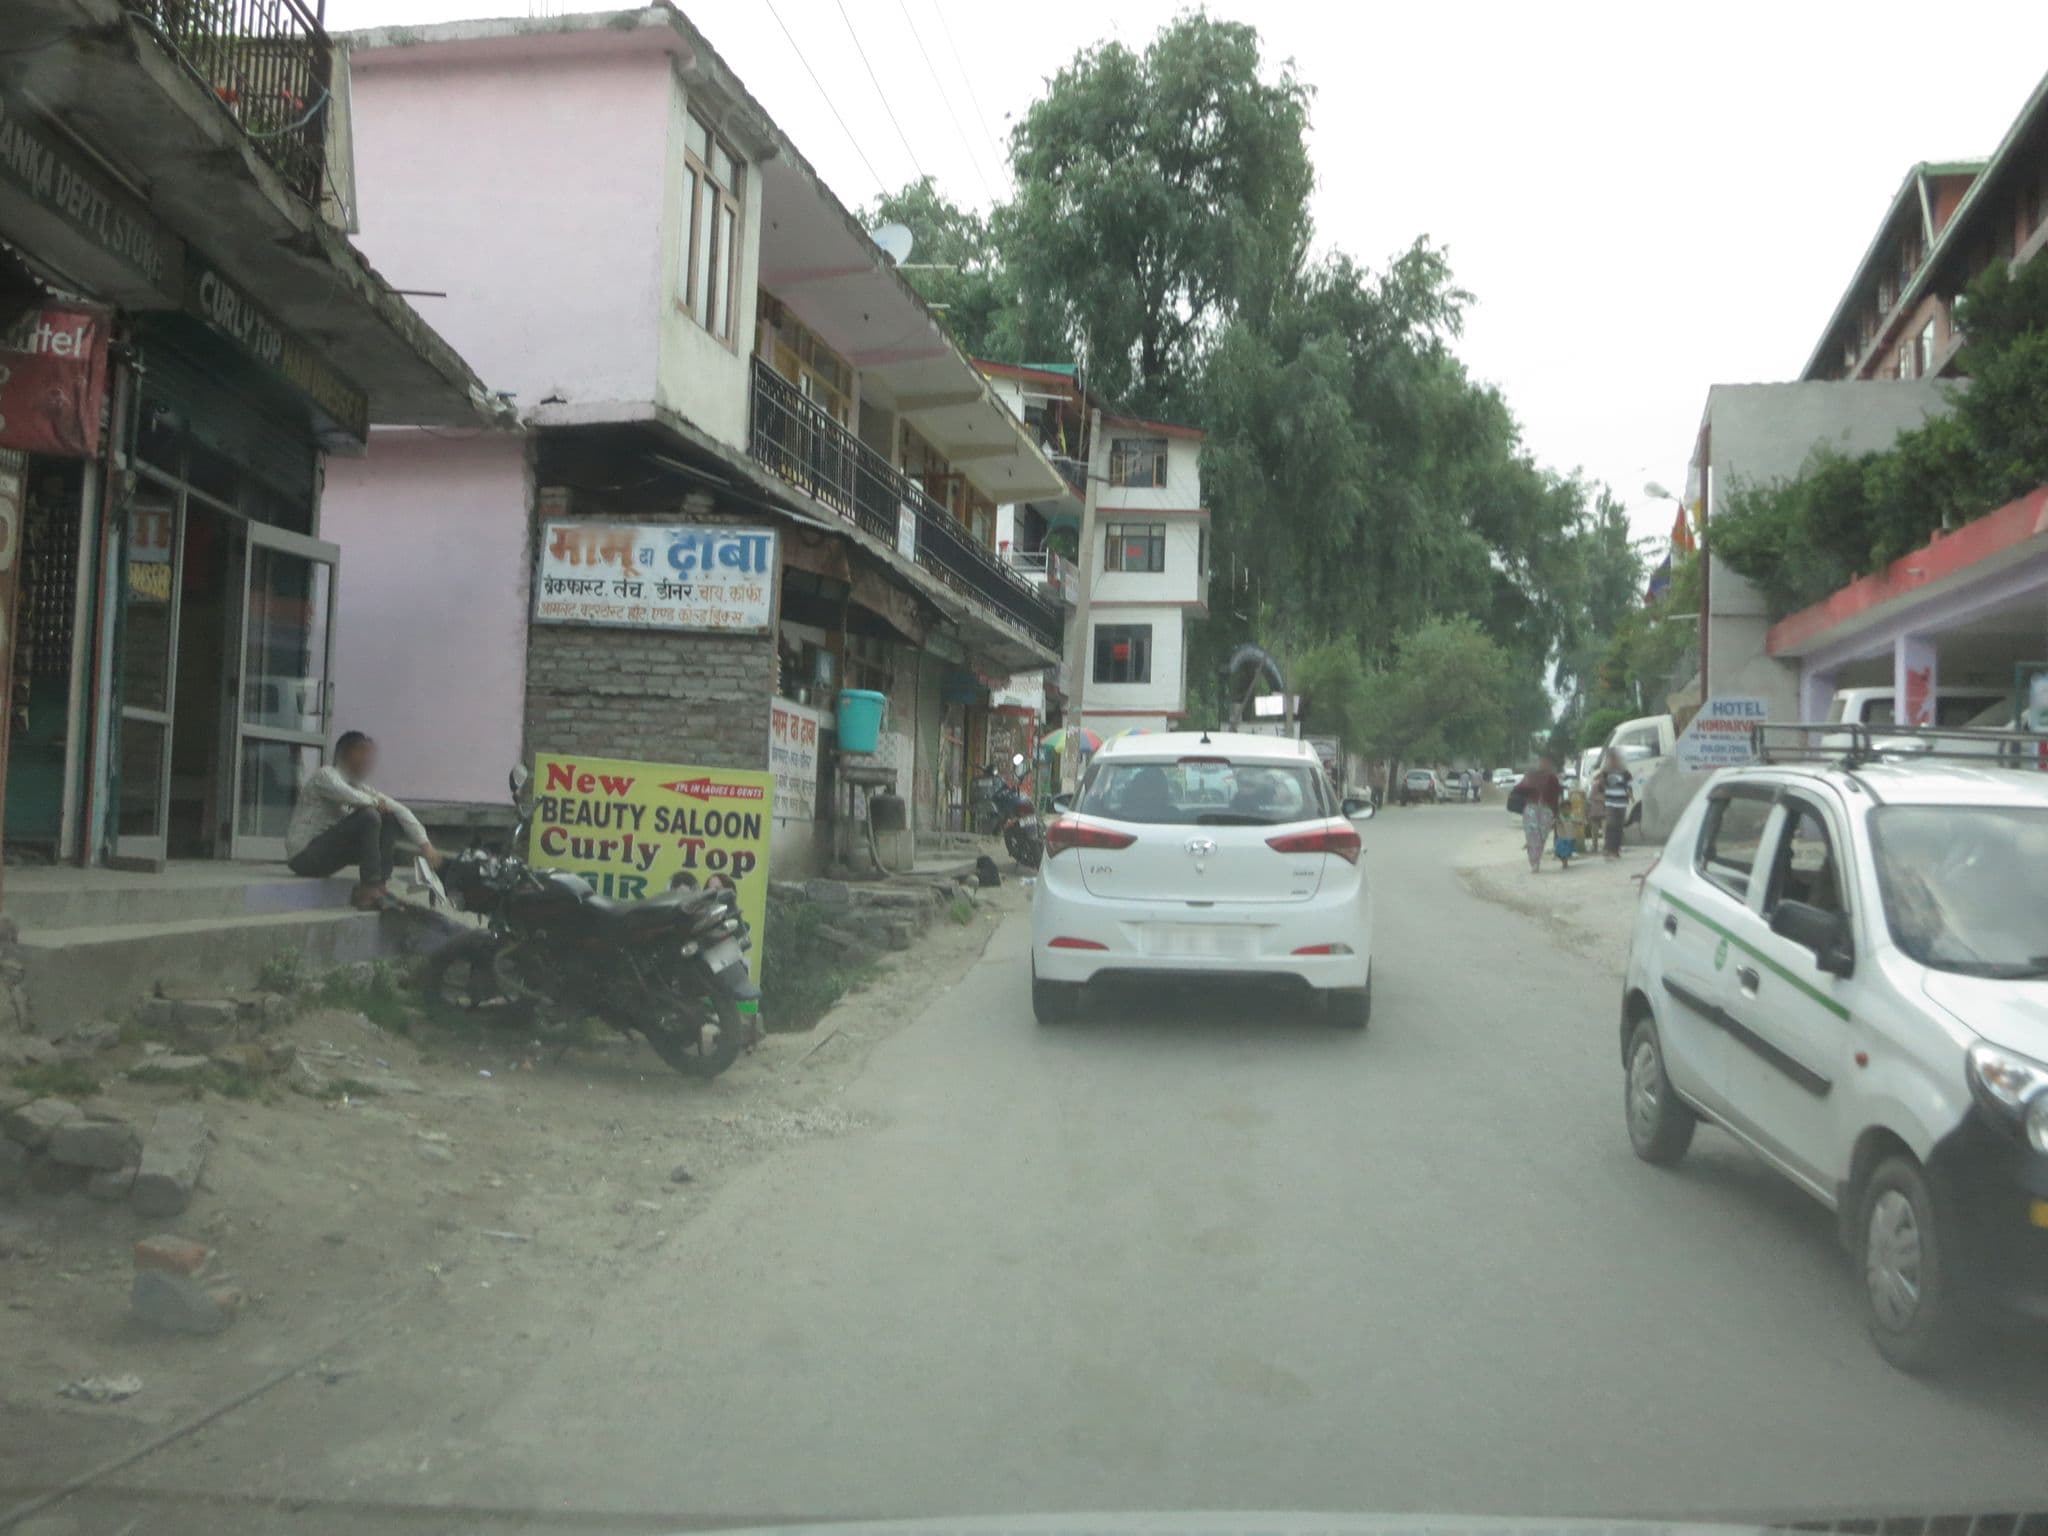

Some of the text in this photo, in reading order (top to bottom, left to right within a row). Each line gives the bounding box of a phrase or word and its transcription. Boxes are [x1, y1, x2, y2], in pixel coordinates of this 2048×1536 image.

[200, 271, 254, 344] CURLY
[254, 317, 282, 366] TOP
[1711, 701, 1765, 716] HOTEL
[545, 762, 636, 797] New
[690, 783, 700, 793] IN
[701, 784, 728, 796] LADIES
[541, 796, 762, 840] BEAUTY SALOON
[540, 826, 756, 880] Curly Top
